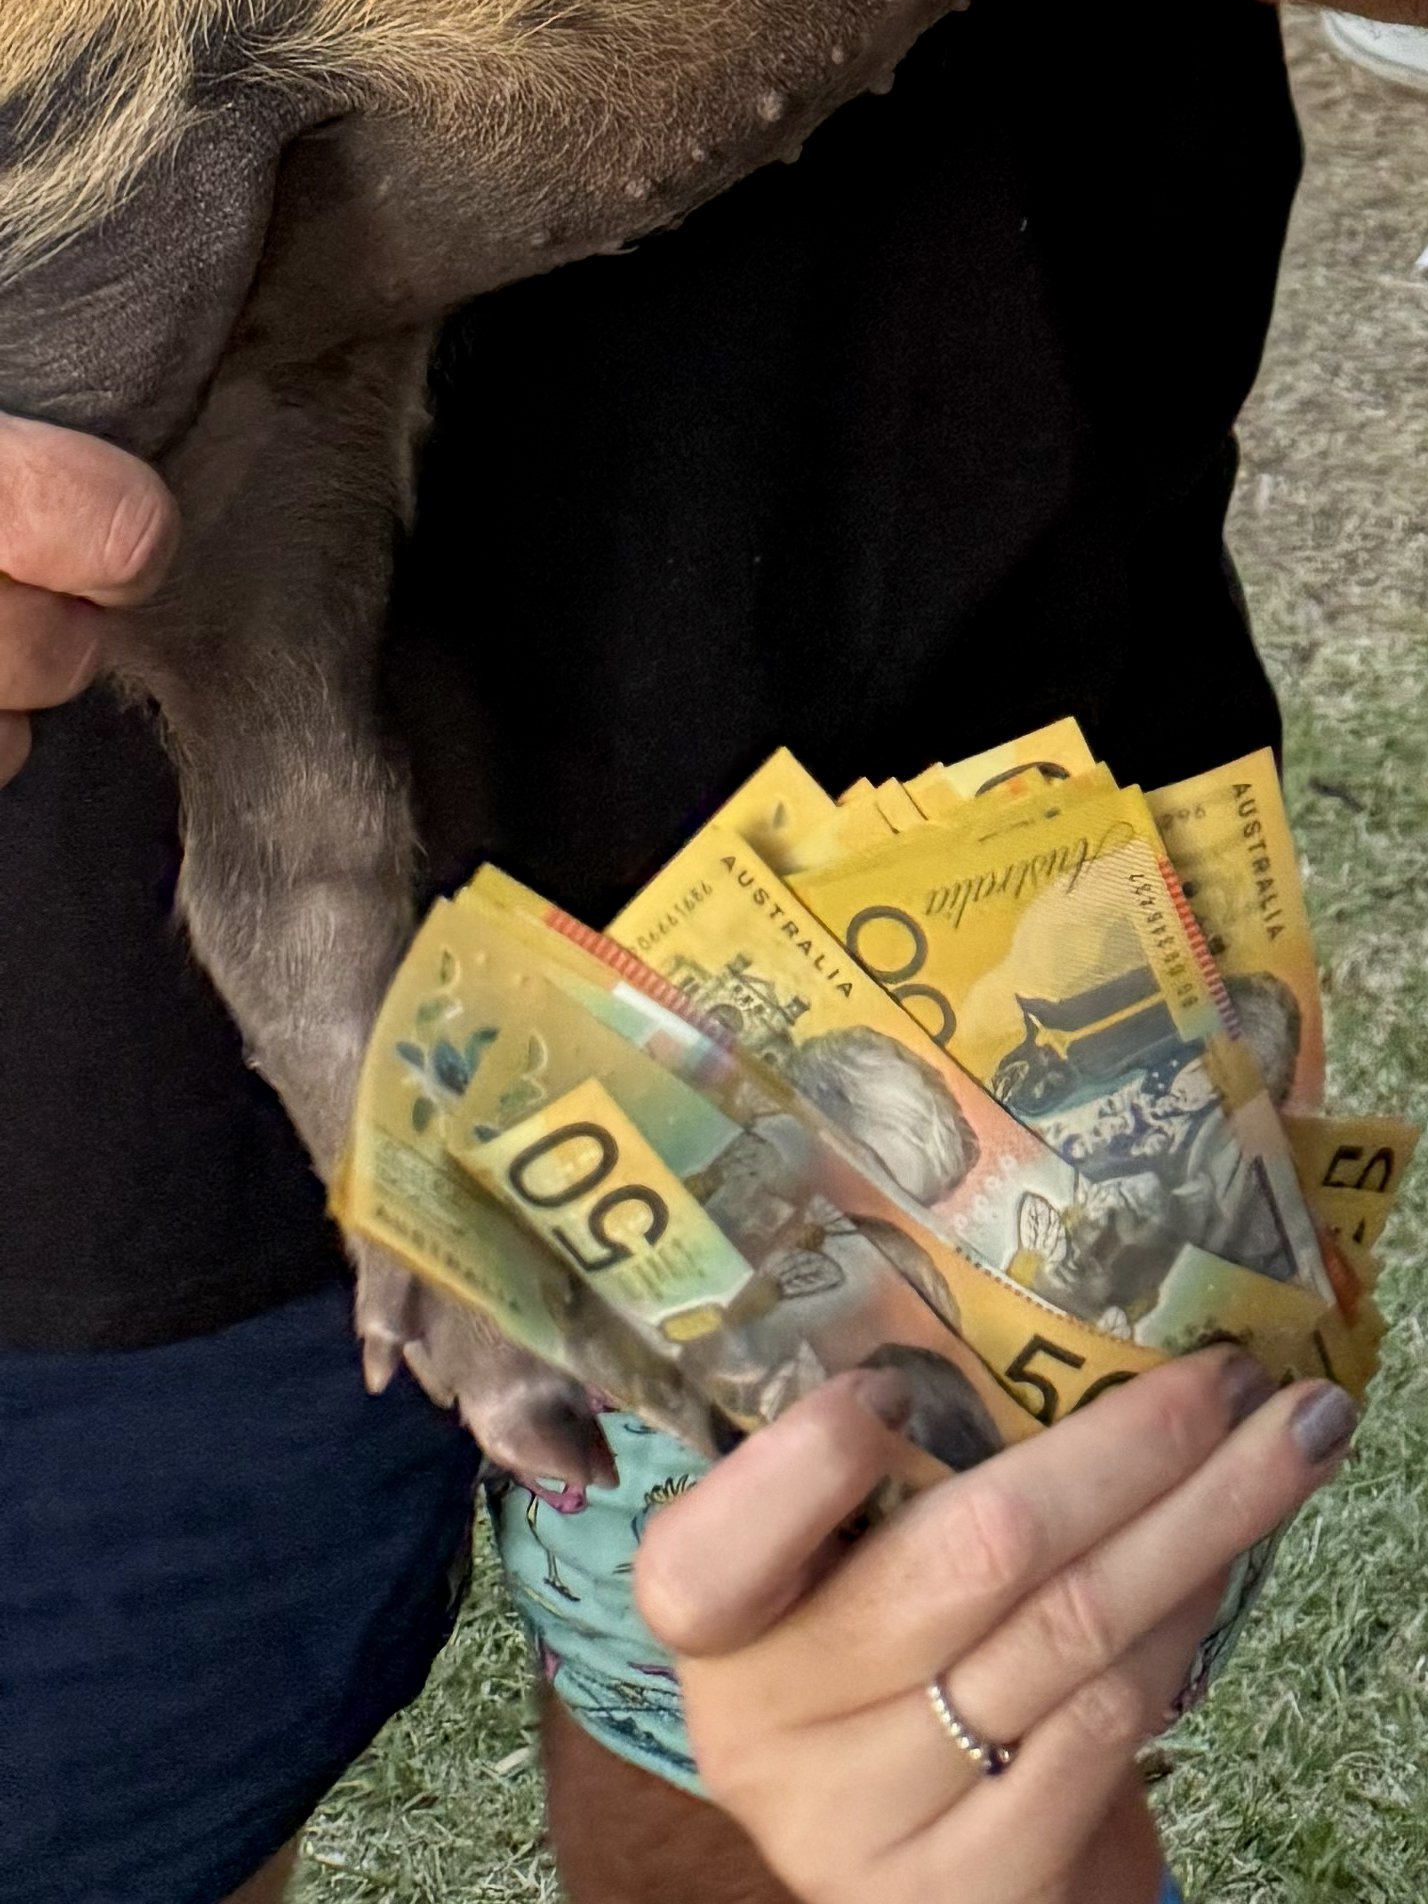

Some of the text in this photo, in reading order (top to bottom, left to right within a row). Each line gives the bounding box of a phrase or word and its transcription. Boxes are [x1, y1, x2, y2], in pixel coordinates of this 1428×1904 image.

[719, 854, 855, 1001] AUSTRALIA
[1231, 781, 1284, 944] AUSTRALIA
[508, 1120, 670, 1274] 50
